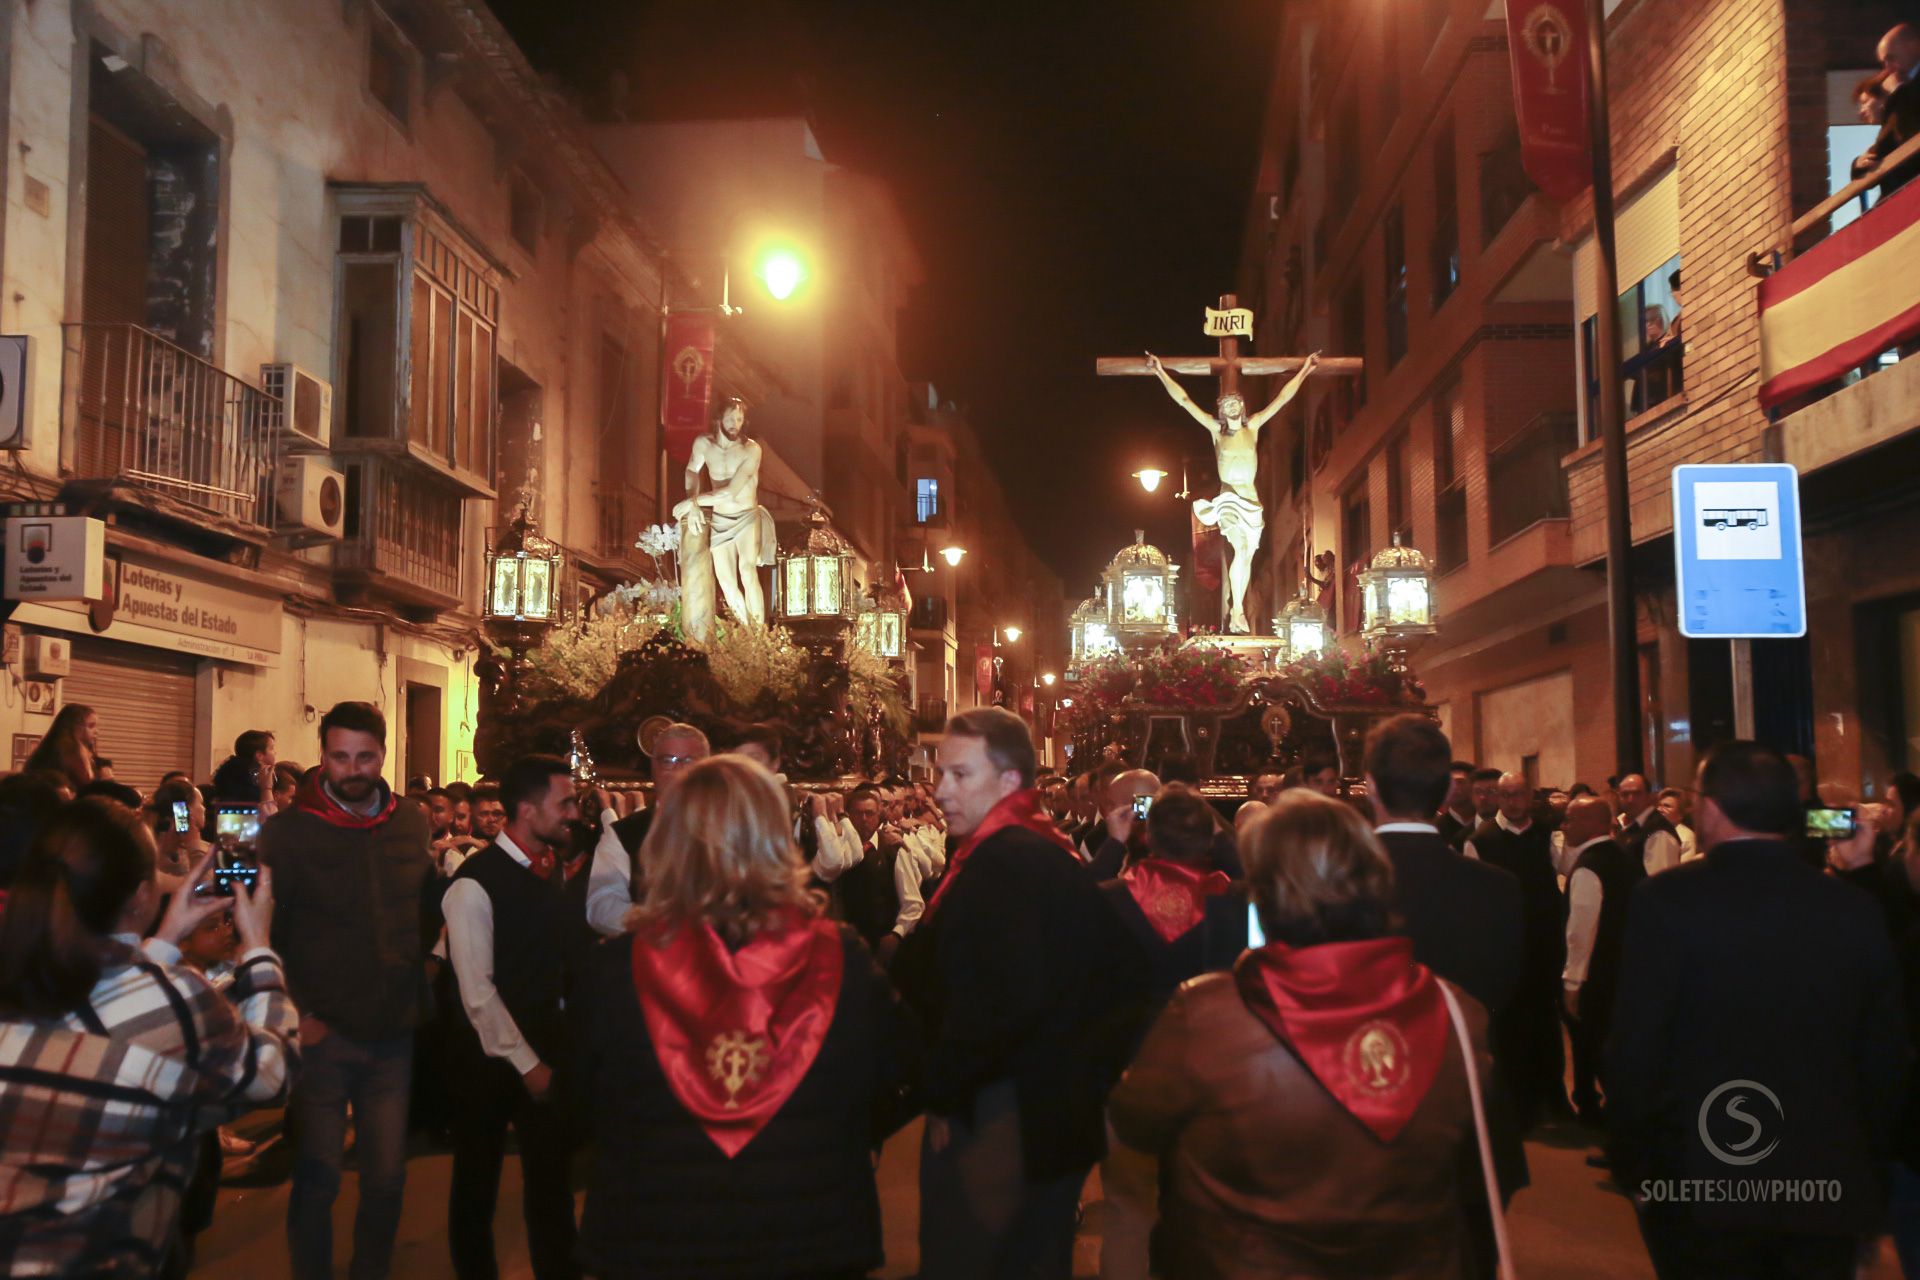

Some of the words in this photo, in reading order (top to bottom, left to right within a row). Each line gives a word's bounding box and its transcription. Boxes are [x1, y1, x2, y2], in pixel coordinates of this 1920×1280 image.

[1213, 315, 1245, 332] INRI
[122, 564, 173, 595] Loterías
[175, 583, 182, 602] y
[122, 593, 178, 622] Apuestas
[181, 606, 199, 627] del
[201, 610, 237, 635] Estado
